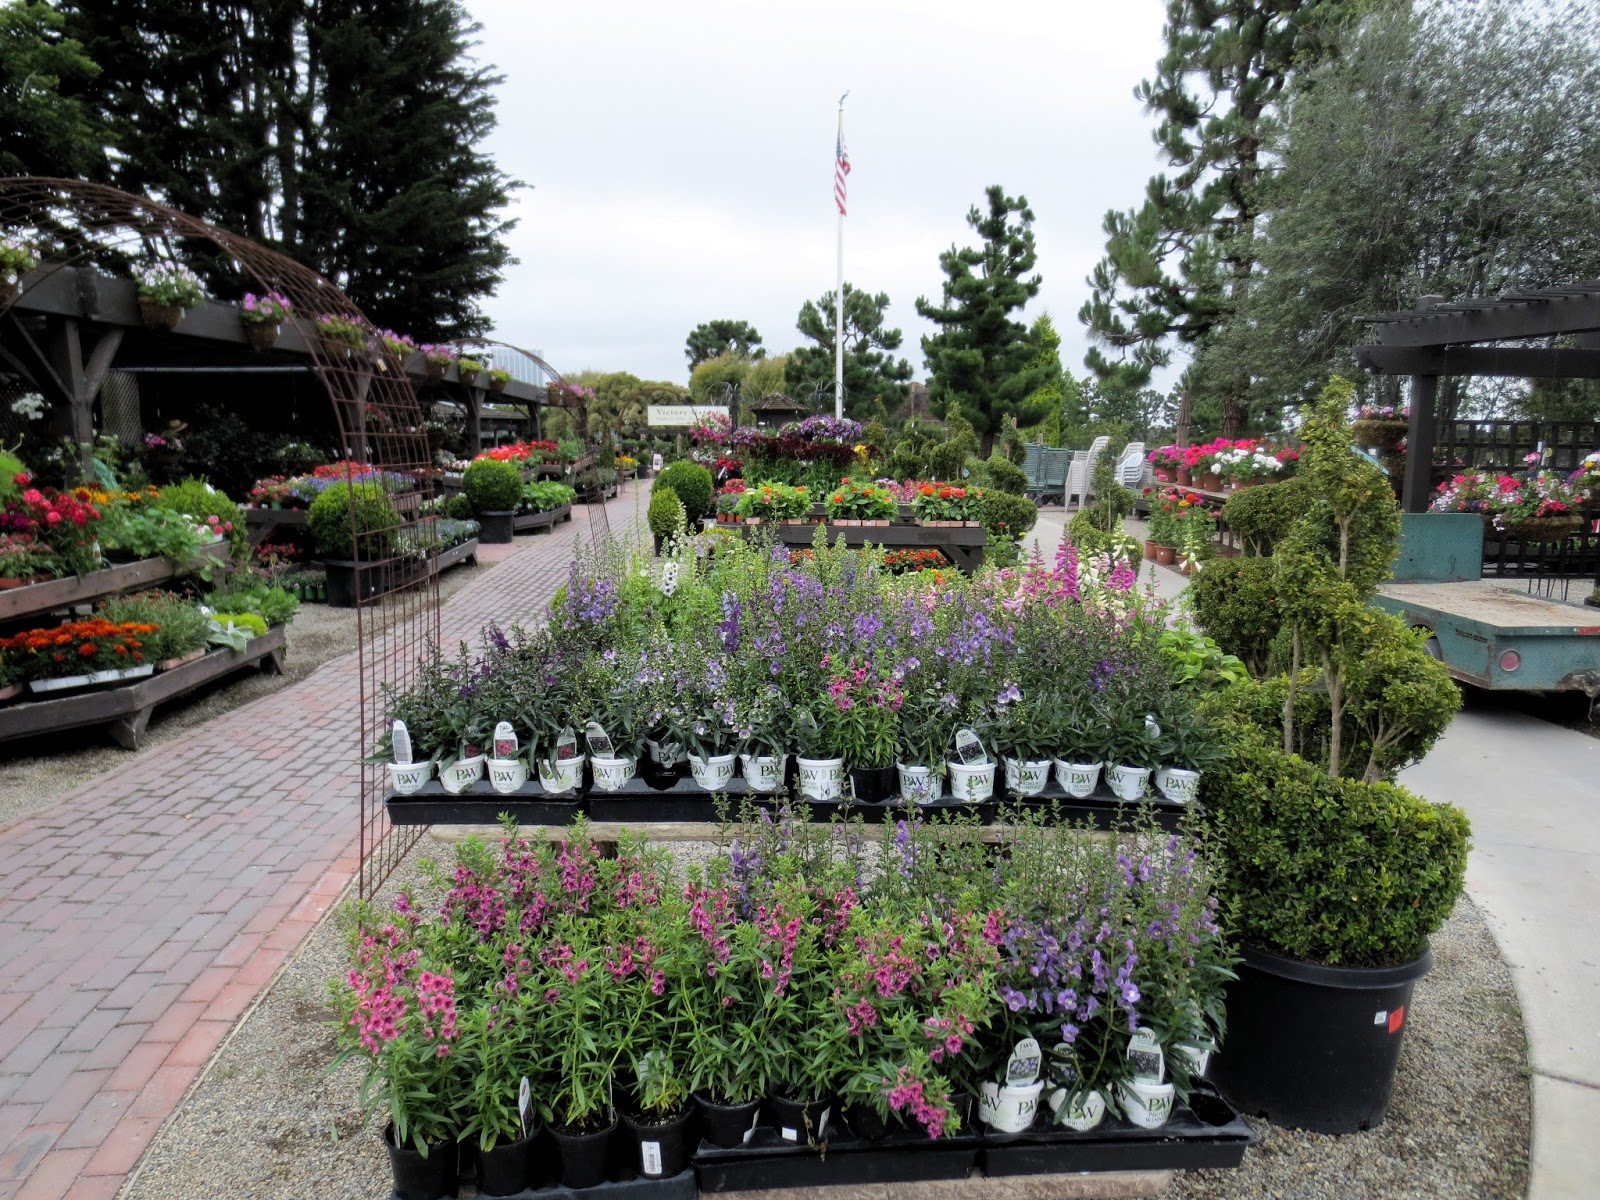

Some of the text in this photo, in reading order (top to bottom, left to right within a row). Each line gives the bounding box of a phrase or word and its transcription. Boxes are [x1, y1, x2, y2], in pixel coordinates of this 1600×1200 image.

[656, 408, 721, 416] Victory Gardn
[397, 773, 420, 785] PW
[456, 767, 479, 781] PW
[494, 770, 516, 782] PW
[1020, 769, 1042, 781] PW
[1071, 772, 1094, 784] PW
[903, 775, 925, 787] PW
[1165, 776, 1190, 790] PW
[1148, 1096, 1170, 1112] PW
